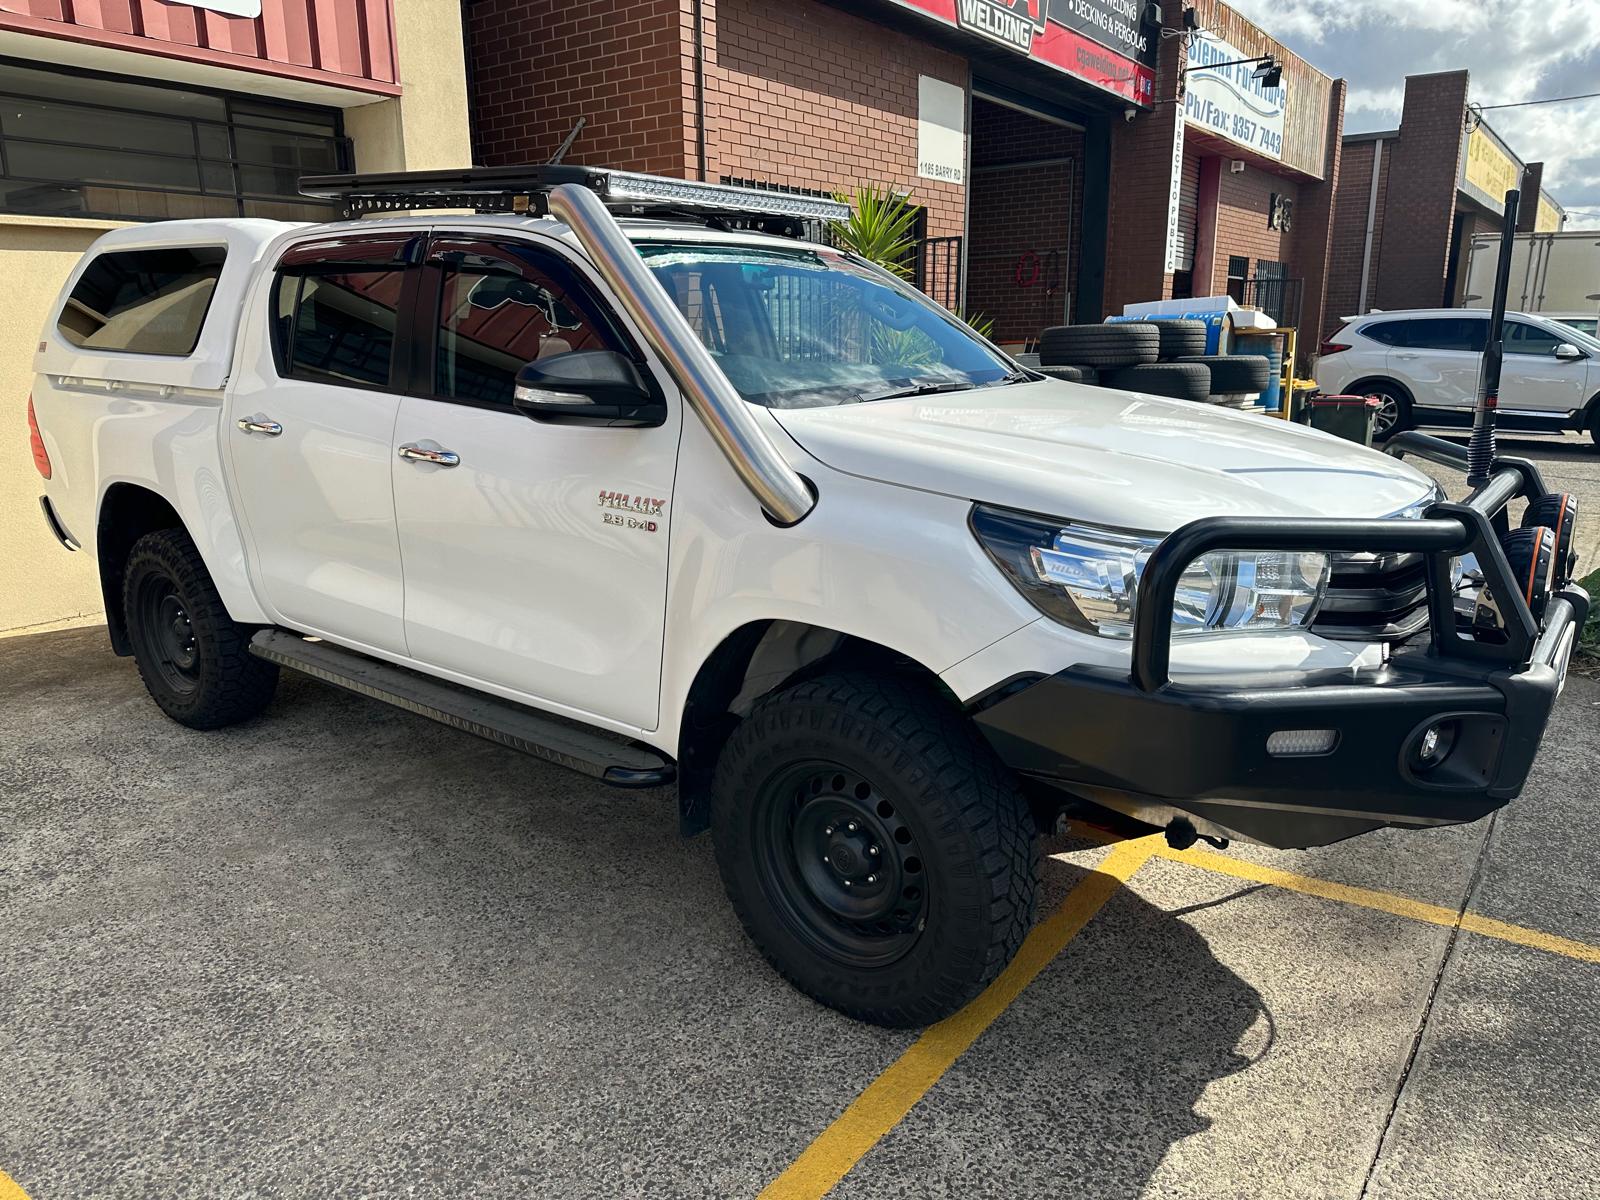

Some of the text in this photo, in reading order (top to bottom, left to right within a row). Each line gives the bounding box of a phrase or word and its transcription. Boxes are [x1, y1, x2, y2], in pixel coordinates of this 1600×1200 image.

[961, 0, 1030, 47] WELDING
[1075, 0, 1108, 30] DECKING
[1108, 17, 1114, 35] &
[1114, 20, 1147, 52] PERGOLAS
[1185, 91, 1282, 154] Ph/Fax: 9357 7443
[935, 164, 953, 178] BARRY
[953, 169, 961, 180] RD
[1167, 108, 1183, 270] DIRECT TO PUBLIC
[598, 490, 666, 516] HILUX
